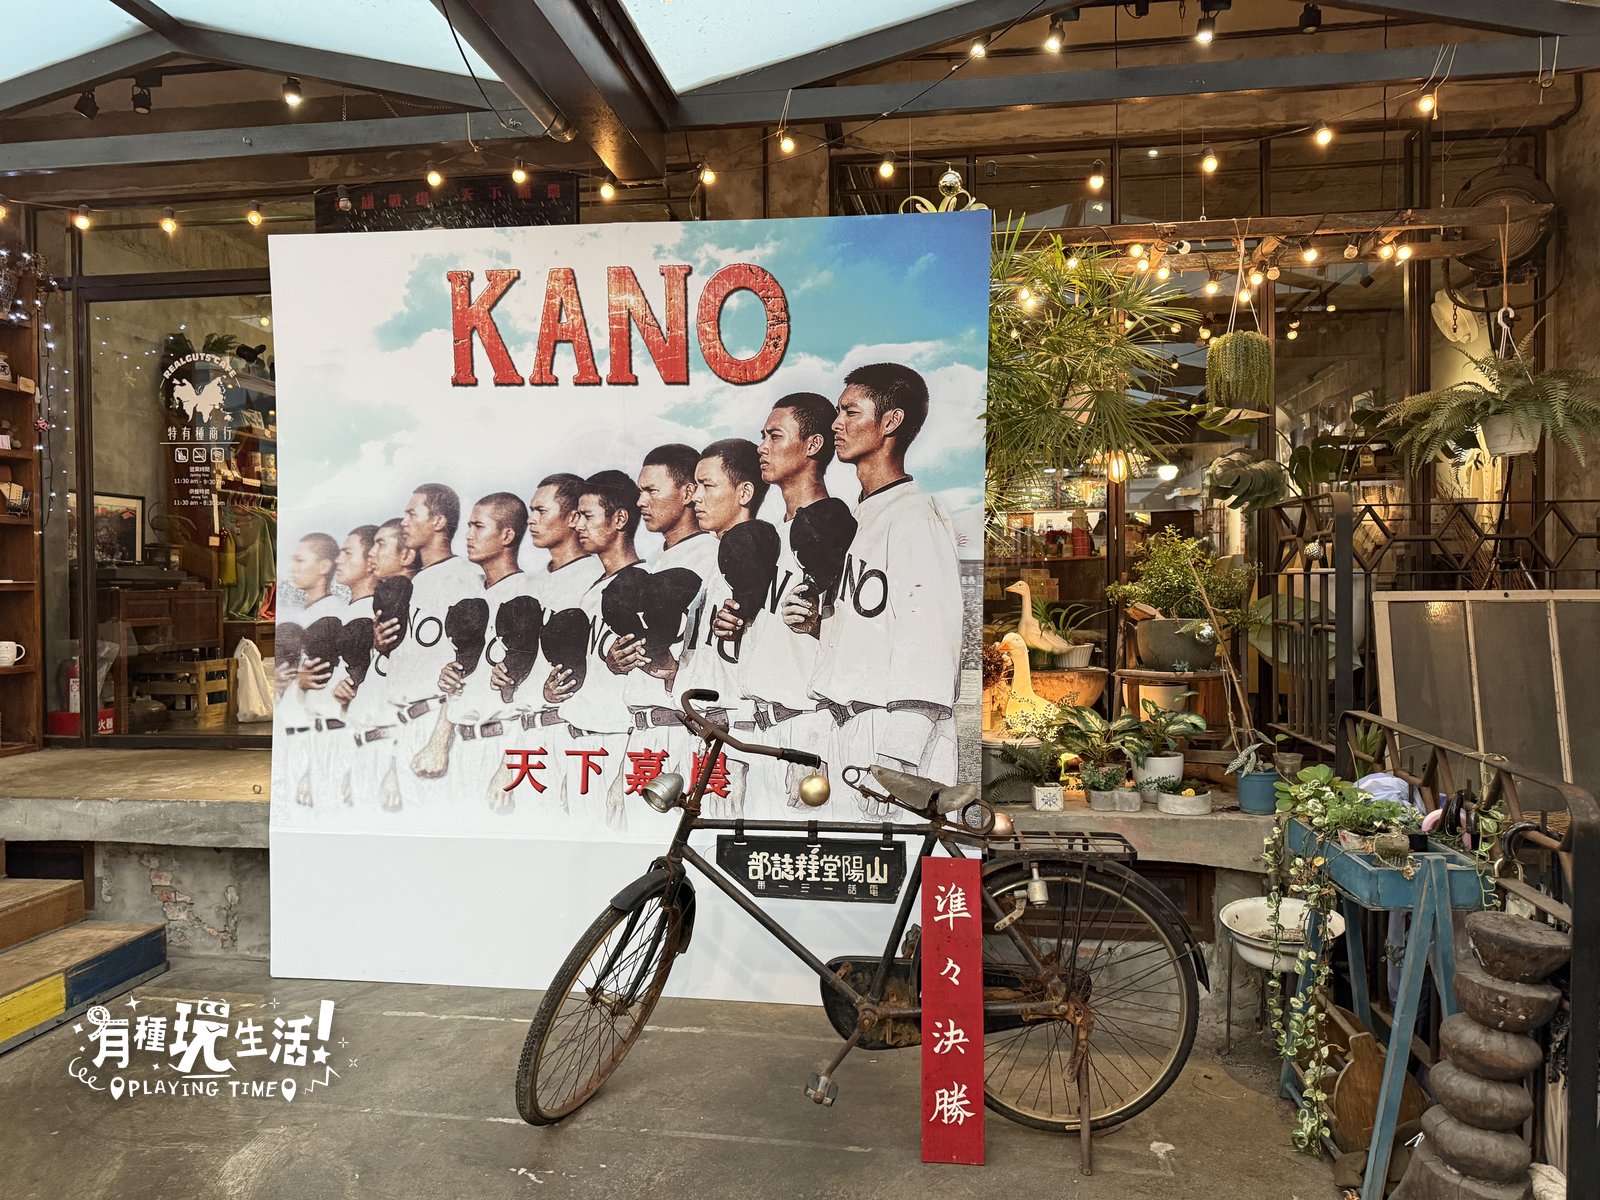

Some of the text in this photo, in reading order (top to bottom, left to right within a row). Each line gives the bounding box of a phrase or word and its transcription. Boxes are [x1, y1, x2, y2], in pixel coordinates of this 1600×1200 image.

[446, 262, 791, 387] KANO
[163, 353, 211, 379] REALGUTS
[167, 426, 233, 441] 特有種商行
[503, 746, 731, 798] 天下嘉農
[929, 882, 976, 1126] 準々決勝
